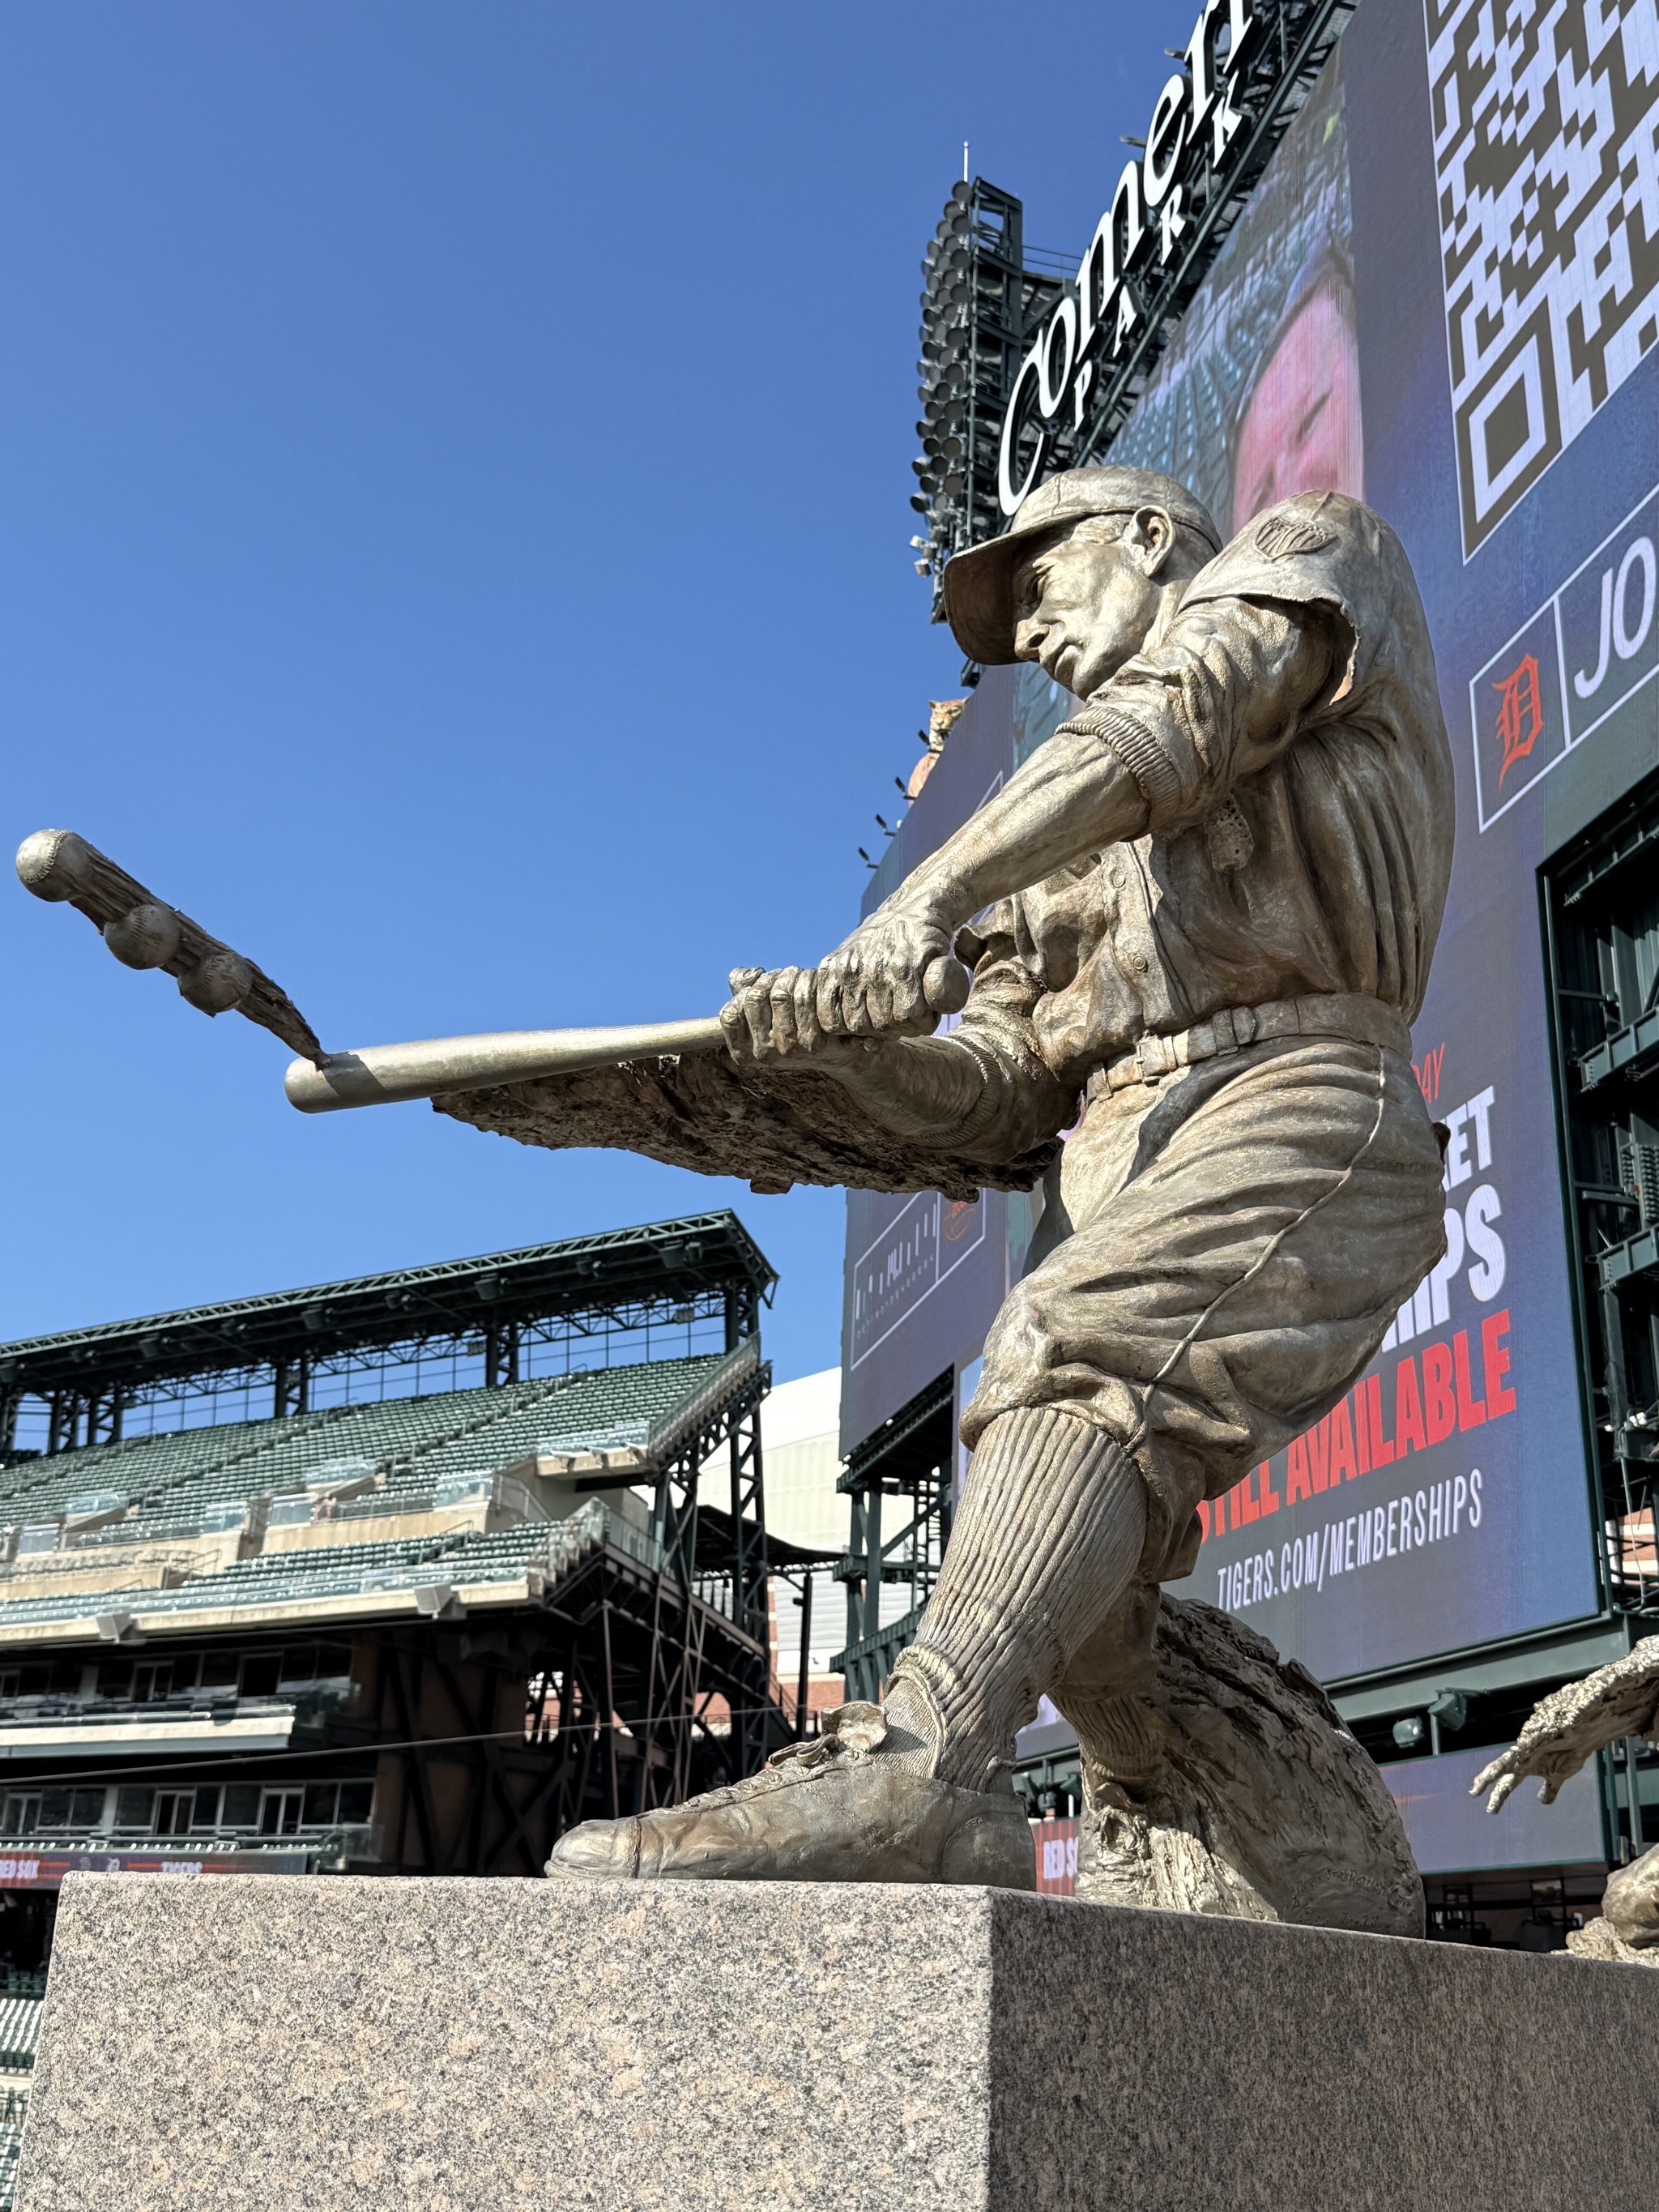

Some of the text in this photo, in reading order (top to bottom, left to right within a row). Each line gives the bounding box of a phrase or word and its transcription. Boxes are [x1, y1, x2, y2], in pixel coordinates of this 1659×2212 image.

[1073, 69, 1243, 432] PARK
[1286, 1308, 1516, 1507] AVAILABLE
[1217, 1467, 1483, 1612] TIGERS.COM/MEMBERSHIPS
